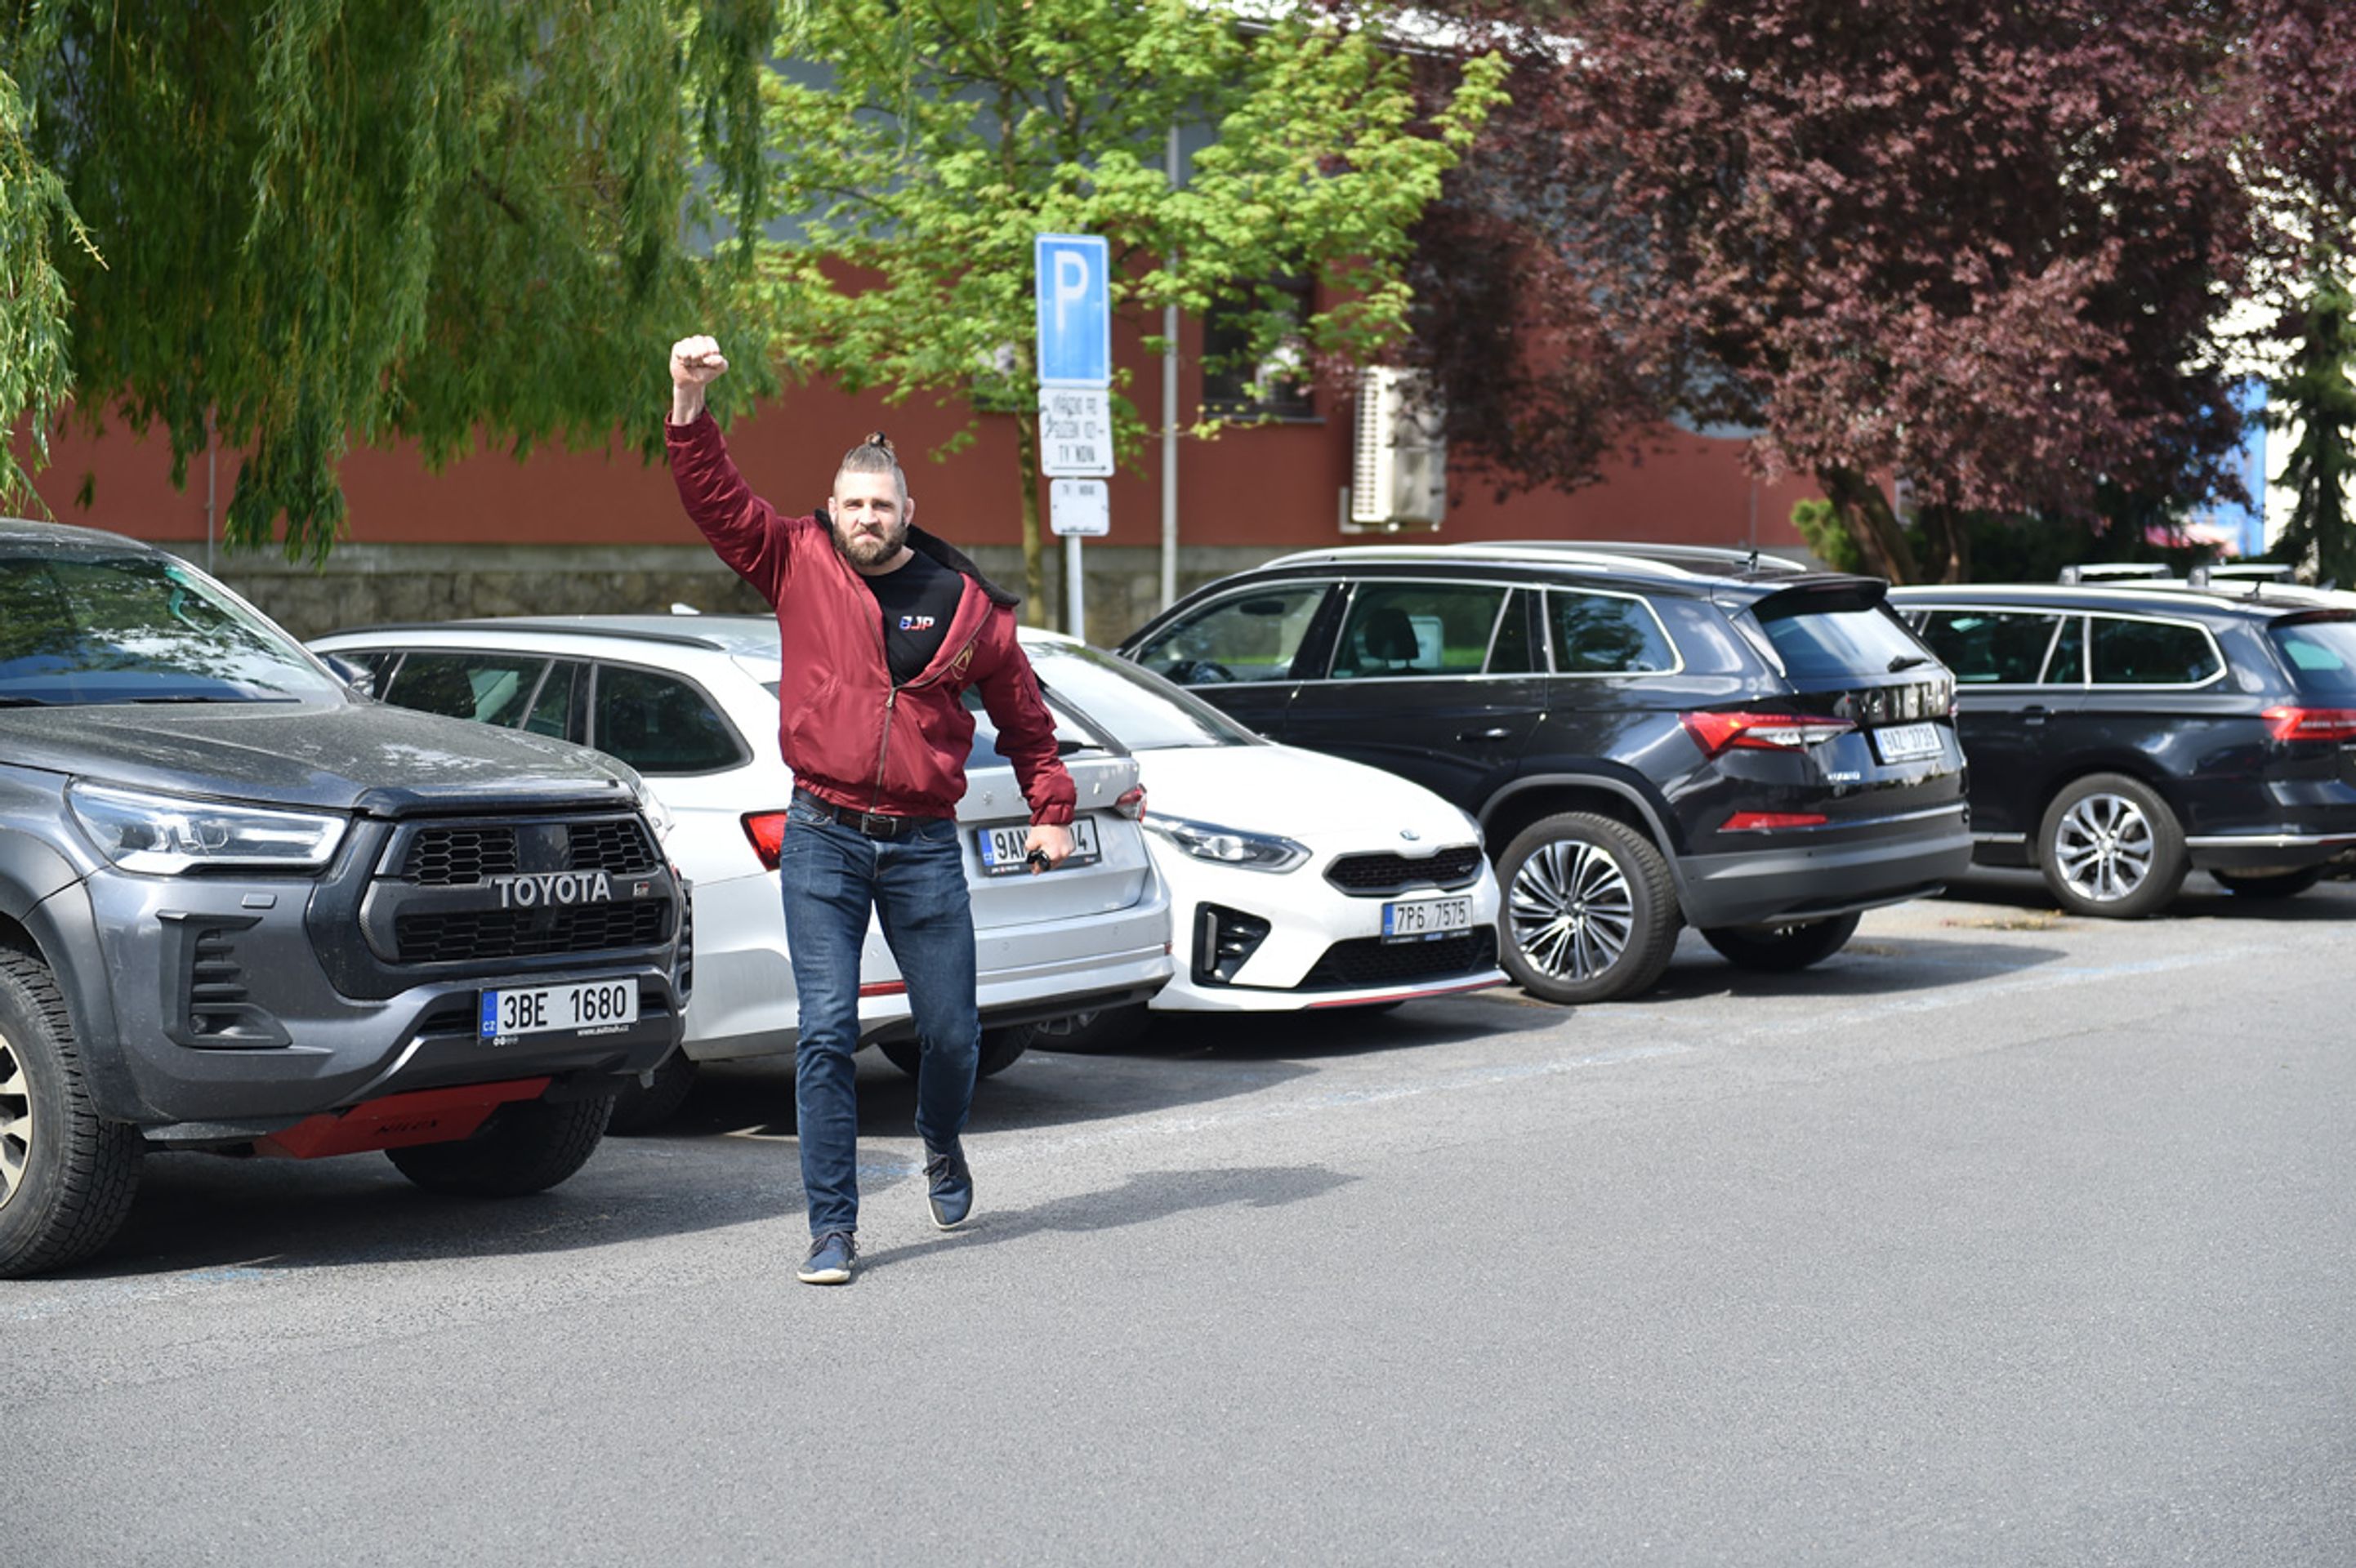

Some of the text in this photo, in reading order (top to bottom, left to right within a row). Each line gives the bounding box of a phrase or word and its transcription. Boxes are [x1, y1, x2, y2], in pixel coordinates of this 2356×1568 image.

[1053, 250, 1090, 331] P
[494, 873, 612, 908] TOYOTA
[1397, 906, 1425, 932] 7P6
[1435, 901, 1466, 928] 7575
[503, 985, 627, 1029] 3BE 1680
[482, 1022, 496, 1031] CZ
